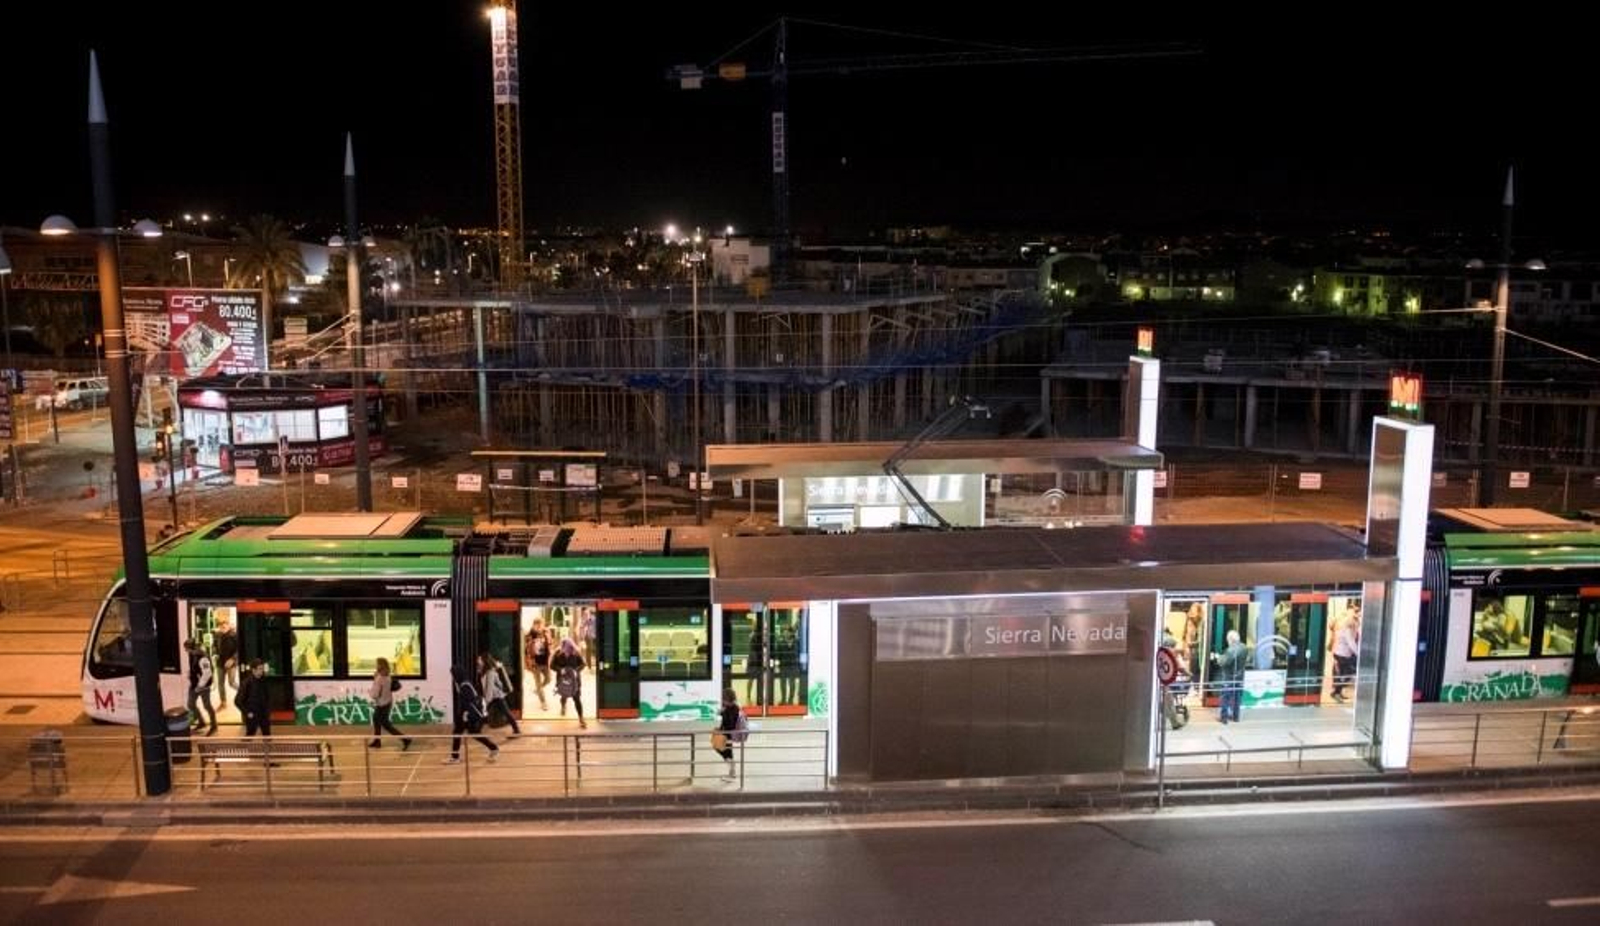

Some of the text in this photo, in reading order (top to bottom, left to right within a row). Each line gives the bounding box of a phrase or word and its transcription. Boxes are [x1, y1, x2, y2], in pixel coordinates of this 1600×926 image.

[984, 622, 1126, 645] Sierra Nevada
[1448, 670, 1546, 702] GRANADA
